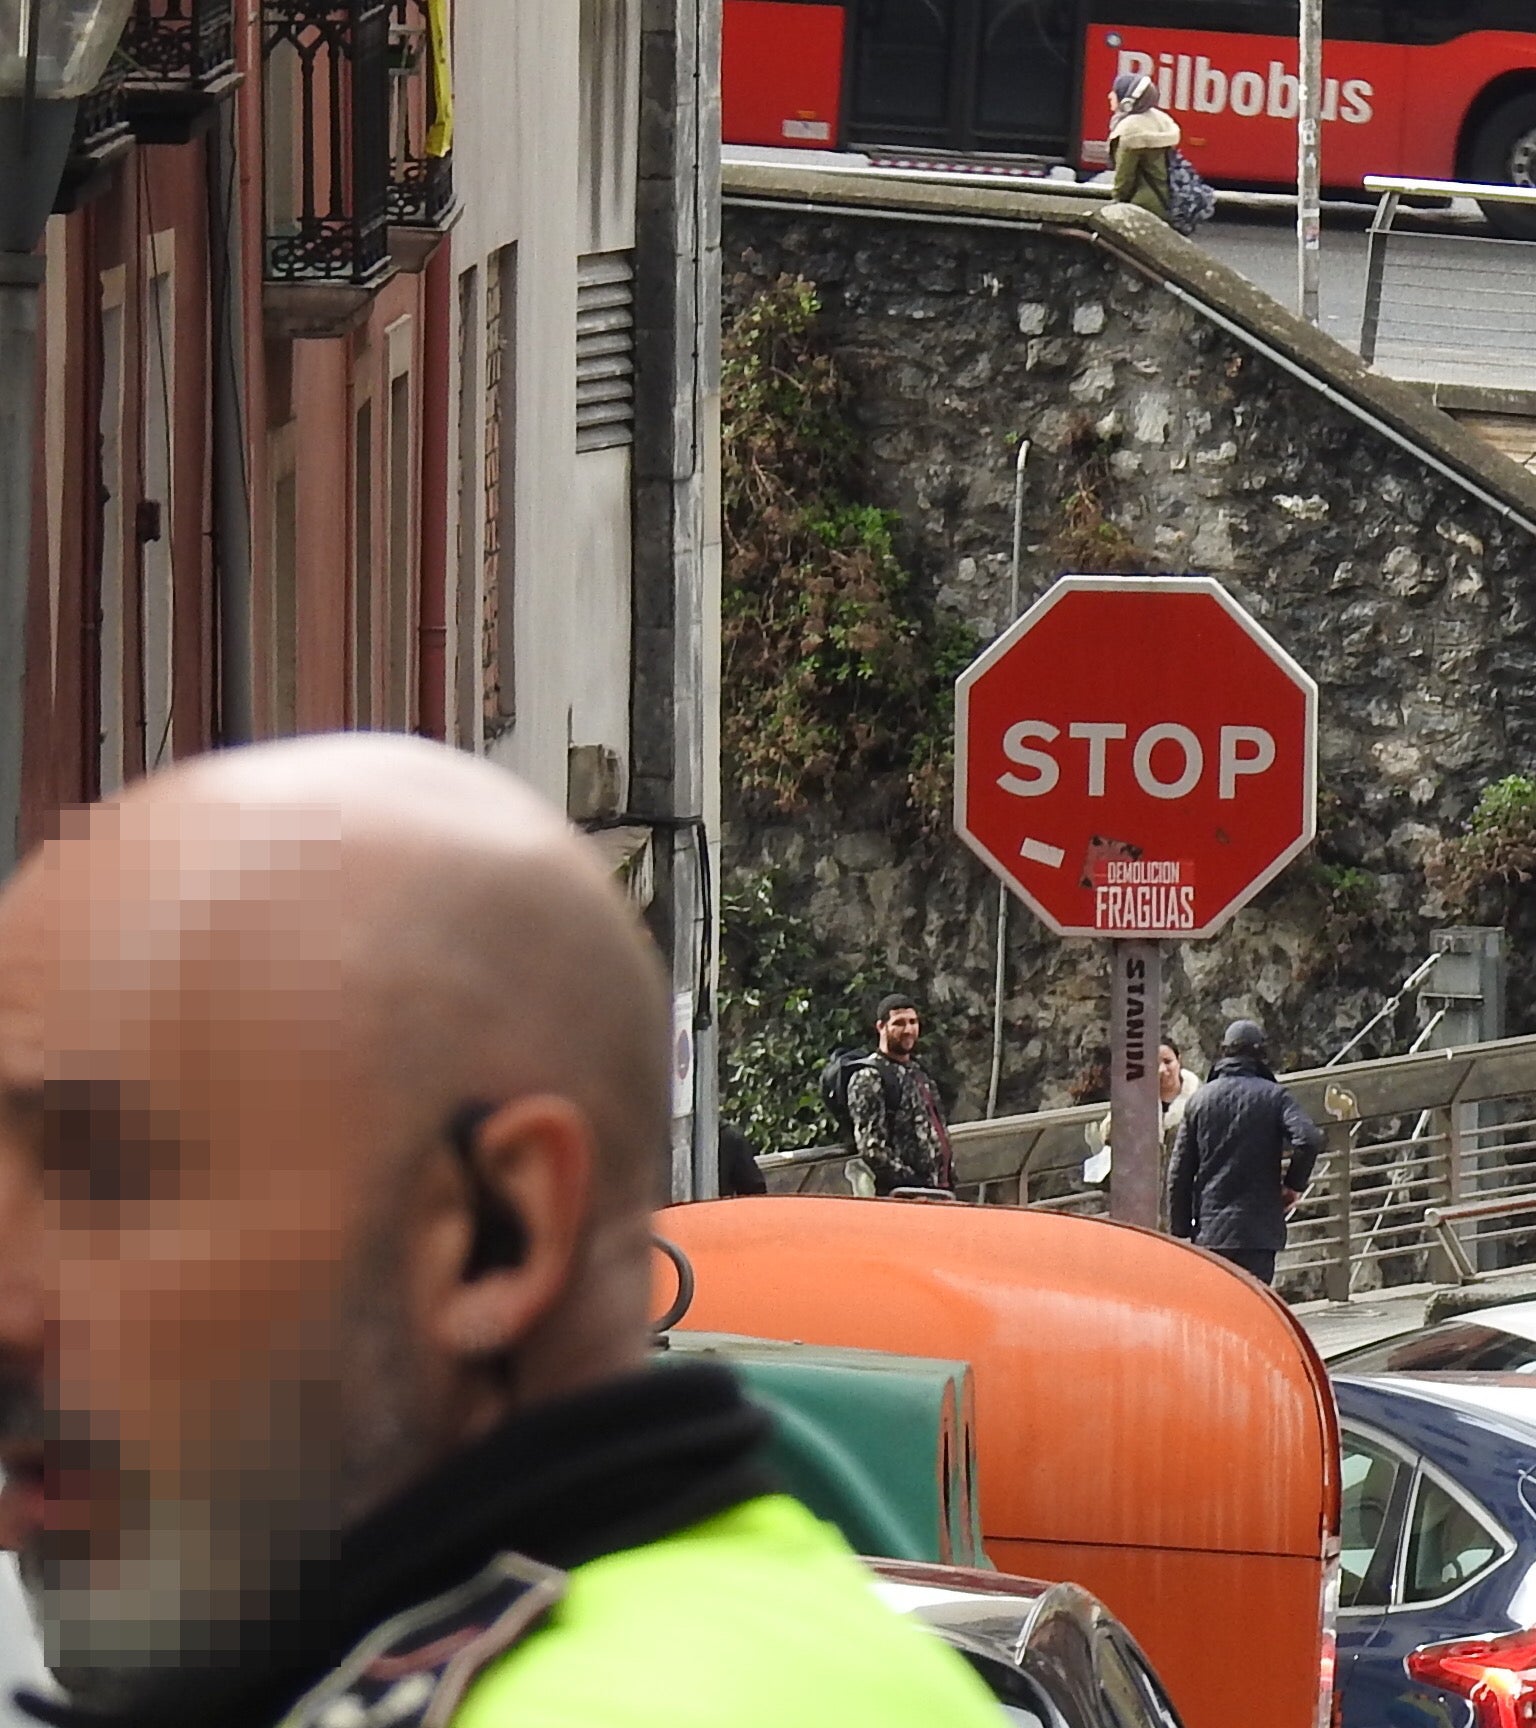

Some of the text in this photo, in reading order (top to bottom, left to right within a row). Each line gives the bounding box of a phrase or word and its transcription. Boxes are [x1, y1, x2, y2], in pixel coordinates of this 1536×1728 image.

[996, 720, 1276, 799] STOP
[1107, 861, 1180, 884] DEMOLICION
[1096, 886, 1194, 928] FRAGUAS
